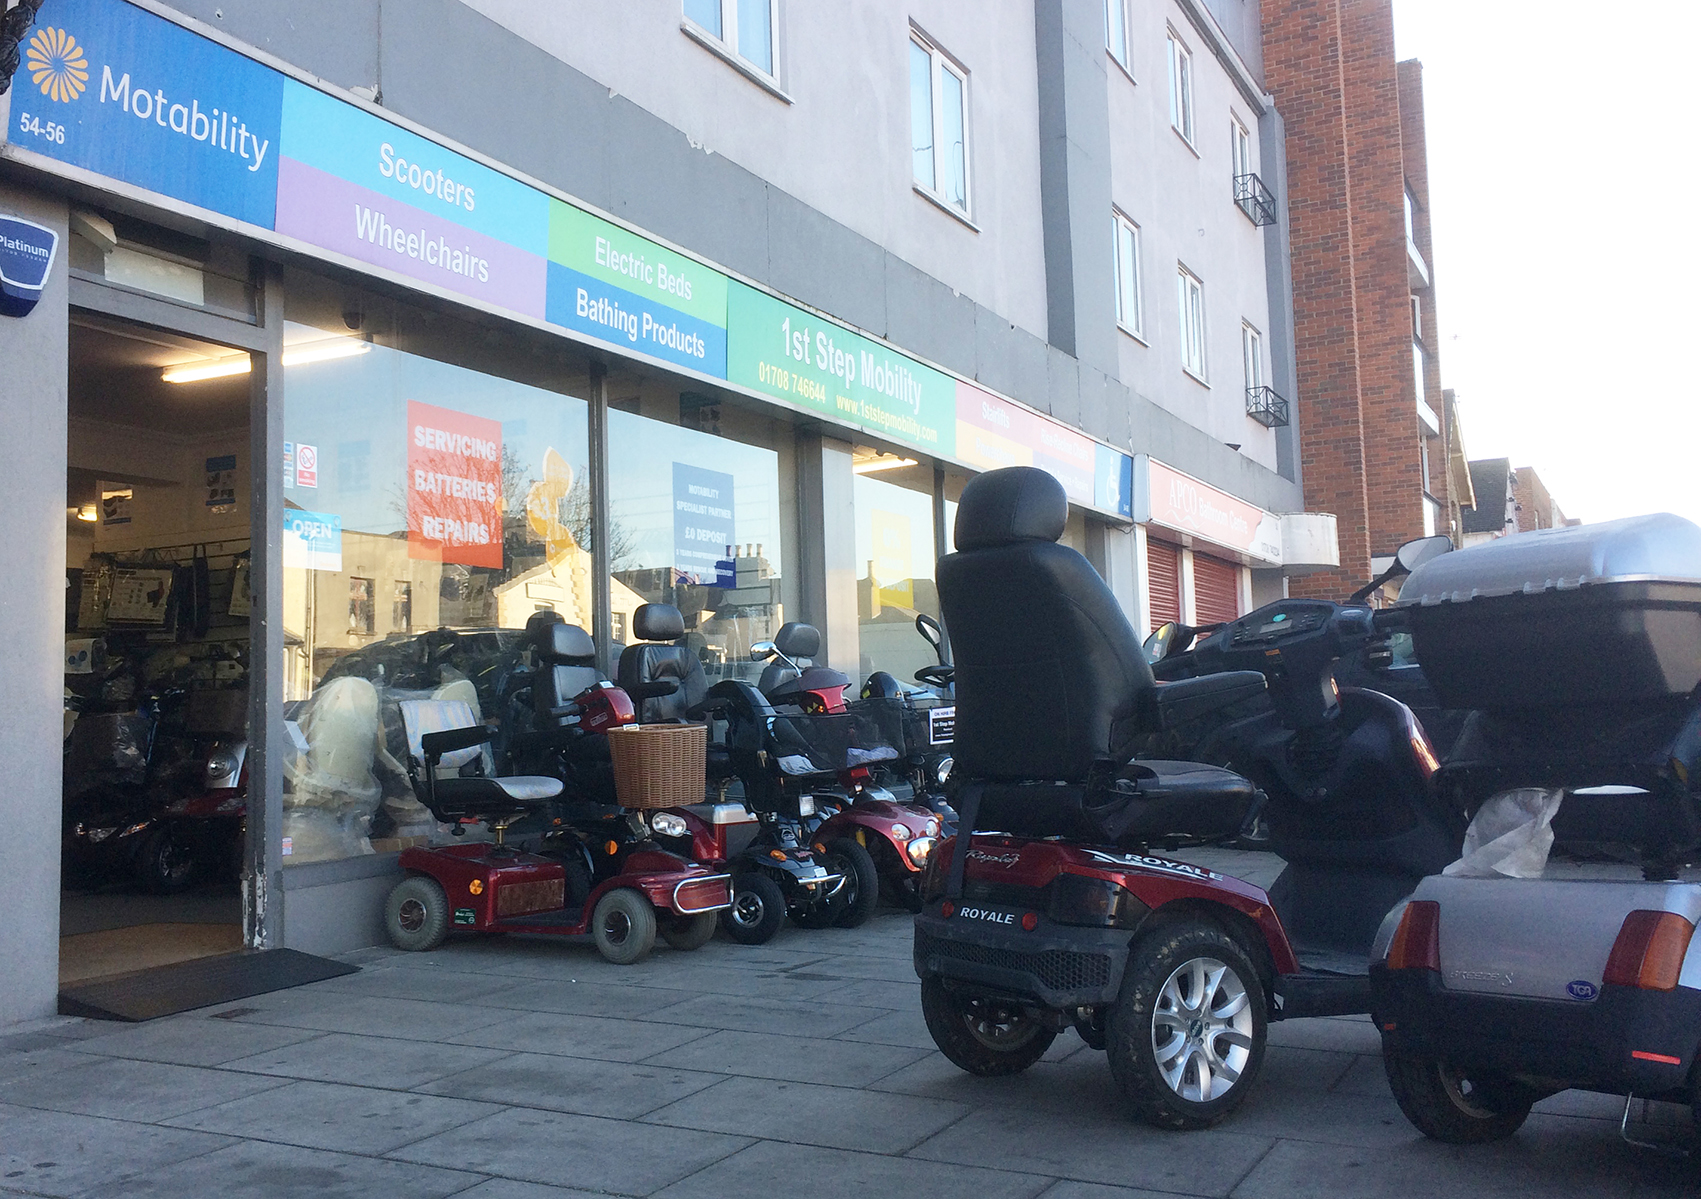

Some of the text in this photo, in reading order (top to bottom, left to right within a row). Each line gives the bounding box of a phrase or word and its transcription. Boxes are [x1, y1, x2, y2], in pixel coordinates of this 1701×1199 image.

[19, 112, 66, 145] 54-56
[100, 64, 269, 172] Motability
[379, 142, 476, 212] Scooters
[355, 203, 489, 284] Wheelchairs
[595, 236, 693, 301] Electric Beds
[576, 288, 705, 359] Bathing Products
[758, 361, 826, 404] 01708 746644
[781, 316, 923, 415] 1st Step Mobility
[836, 394, 938, 444] www.1ststepmobility.com
[414, 425, 497, 460] SERVICING
[414, 469, 496, 503] BATTERIES
[689, 485, 719, 498] MOTABILITY
[677, 501, 731, 519] SPECIALIST PARTNER
[292, 519, 332, 539] OPEN
[423, 515, 490, 545] REPAIRS
[697, 529, 726, 543] DEPOSIT
[1125, 853, 1224, 882] ROYALE
[959, 906, 1016, 925] ROYALE
[1572, 984, 1592, 997] TGA
